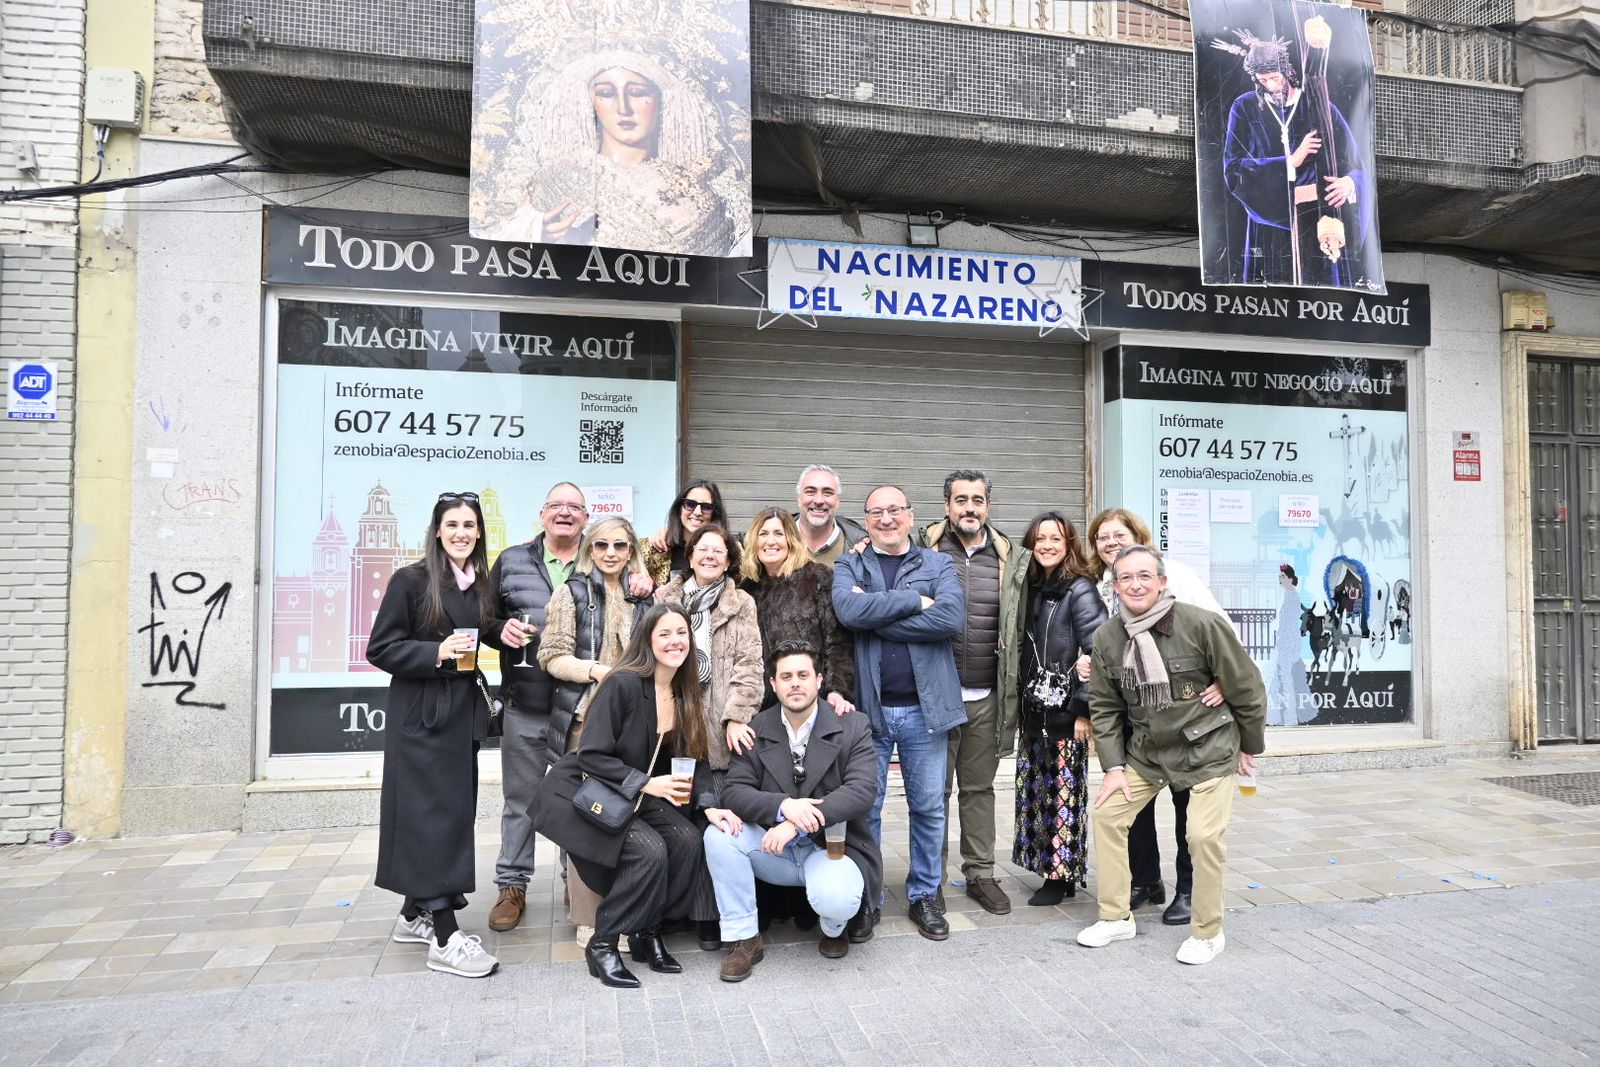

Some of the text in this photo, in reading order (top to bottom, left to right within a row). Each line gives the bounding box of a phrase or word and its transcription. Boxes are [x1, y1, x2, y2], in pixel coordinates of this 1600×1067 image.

[299, 225, 435, 273] TODO
[450, 245, 562, 281] PASA
[817, 247, 1036, 285] NACIMIENTO
[789, 285, 1063, 323] DEL NAZARENO
[1123, 281, 1207, 313] TODOS
[1214, 294, 1289, 319] PASAN
[1297, 299, 1345, 322] POR
[323, 317, 462, 353] IMAGINA
[472, 331, 554, 357] VIVIR
[19, 375, 47, 389] ADT
[1139, 360, 1225, 388] IMAGINA
[1231, 371, 1258, 388] TU
[1264, 371, 1343, 392] NEGOCIO
[335, 381, 424, 400] Infórmate
[580, 391, 633, 404] Descárgate
[580, 402, 638, 414] Información
[334, 409, 525, 438] 607 44 57 75
[1159, 413, 1224, 429] Infórmate
[334, 443, 546, 462] zenobia@espacioZenobia.es
[1159, 437, 1298, 462] 607 44 57 75
[1455, 451, 1479, 459] Alarma
[1159, 466, 1314, 483] zenobia@espacioZenobia.es
[591, 503, 623, 513] 79670
[1287, 509, 1312, 518] 79670
[1298, 691, 1338, 709] POR
